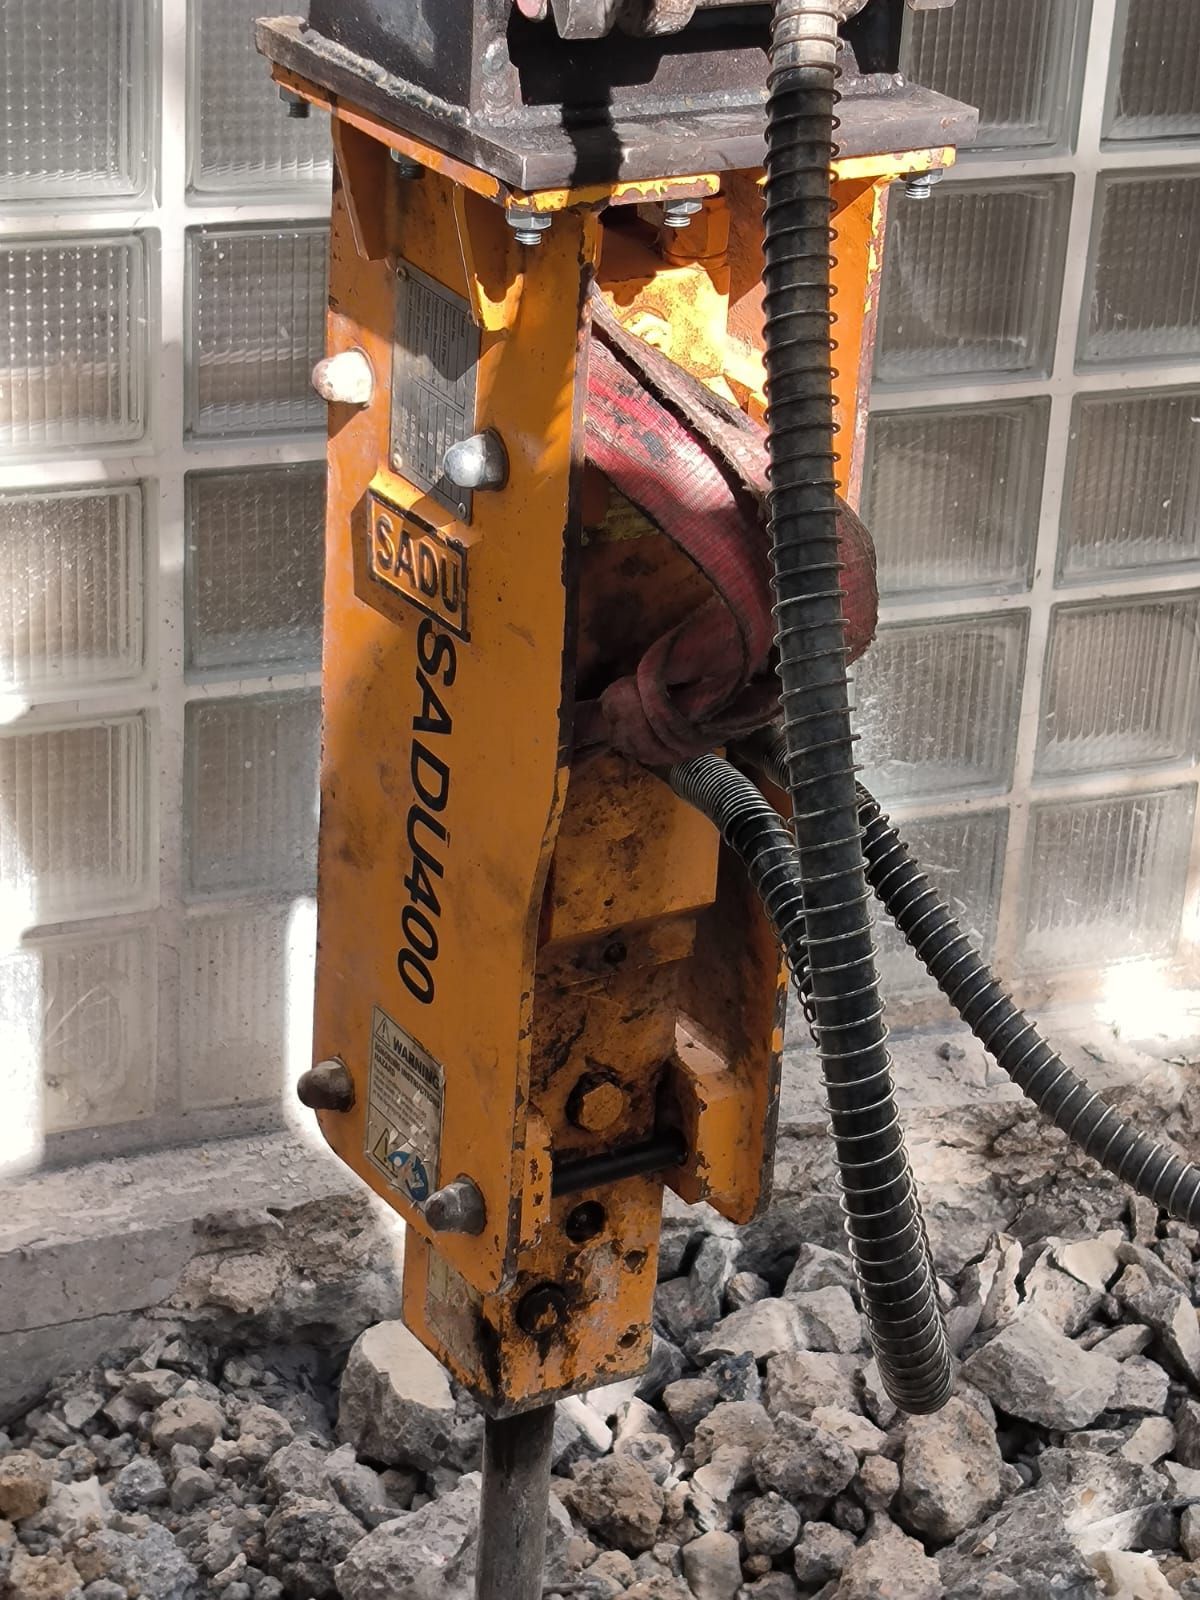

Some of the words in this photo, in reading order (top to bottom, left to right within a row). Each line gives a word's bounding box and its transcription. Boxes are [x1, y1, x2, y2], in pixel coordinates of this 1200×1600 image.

[376, 513, 459, 613] SADU
[398, 617, 457, 1005] SADU400
[393, 1036, 440, 1090] WARNING
